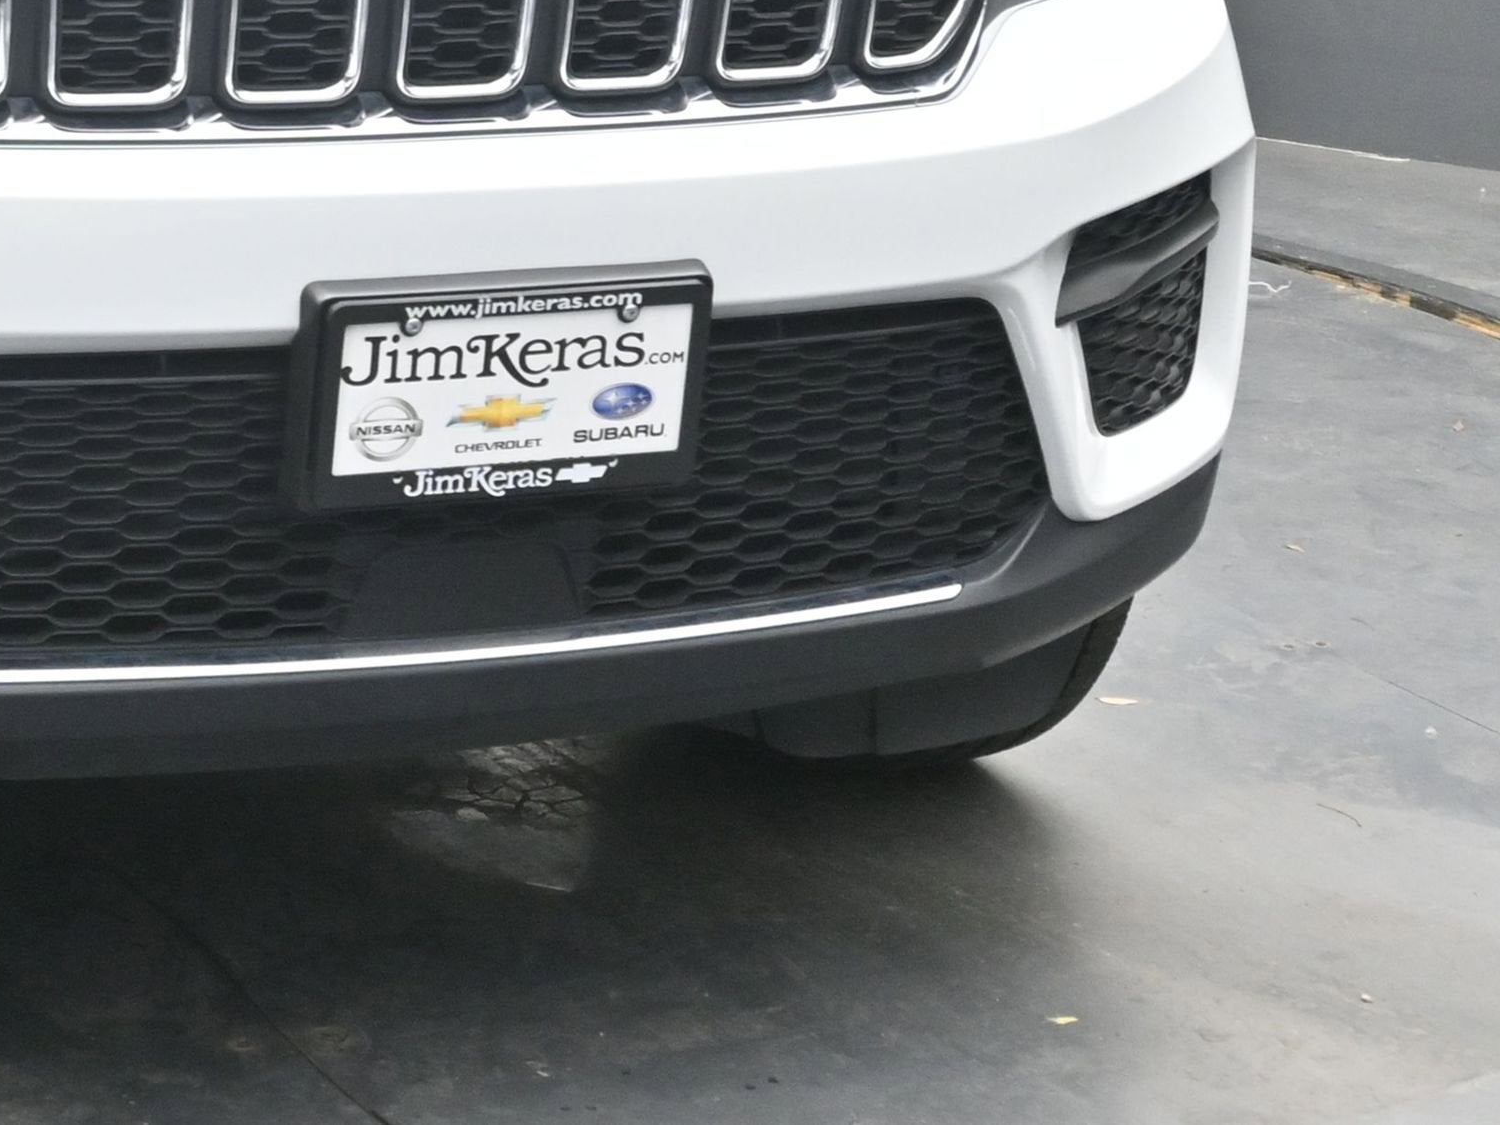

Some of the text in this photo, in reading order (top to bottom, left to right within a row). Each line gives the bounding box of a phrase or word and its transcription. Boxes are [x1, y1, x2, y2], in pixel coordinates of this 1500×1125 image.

[404, 291, 643, 320] www.jimkeras.com
[355, 422, 665, 454] NISSAN CHEVROLET SUBARU
